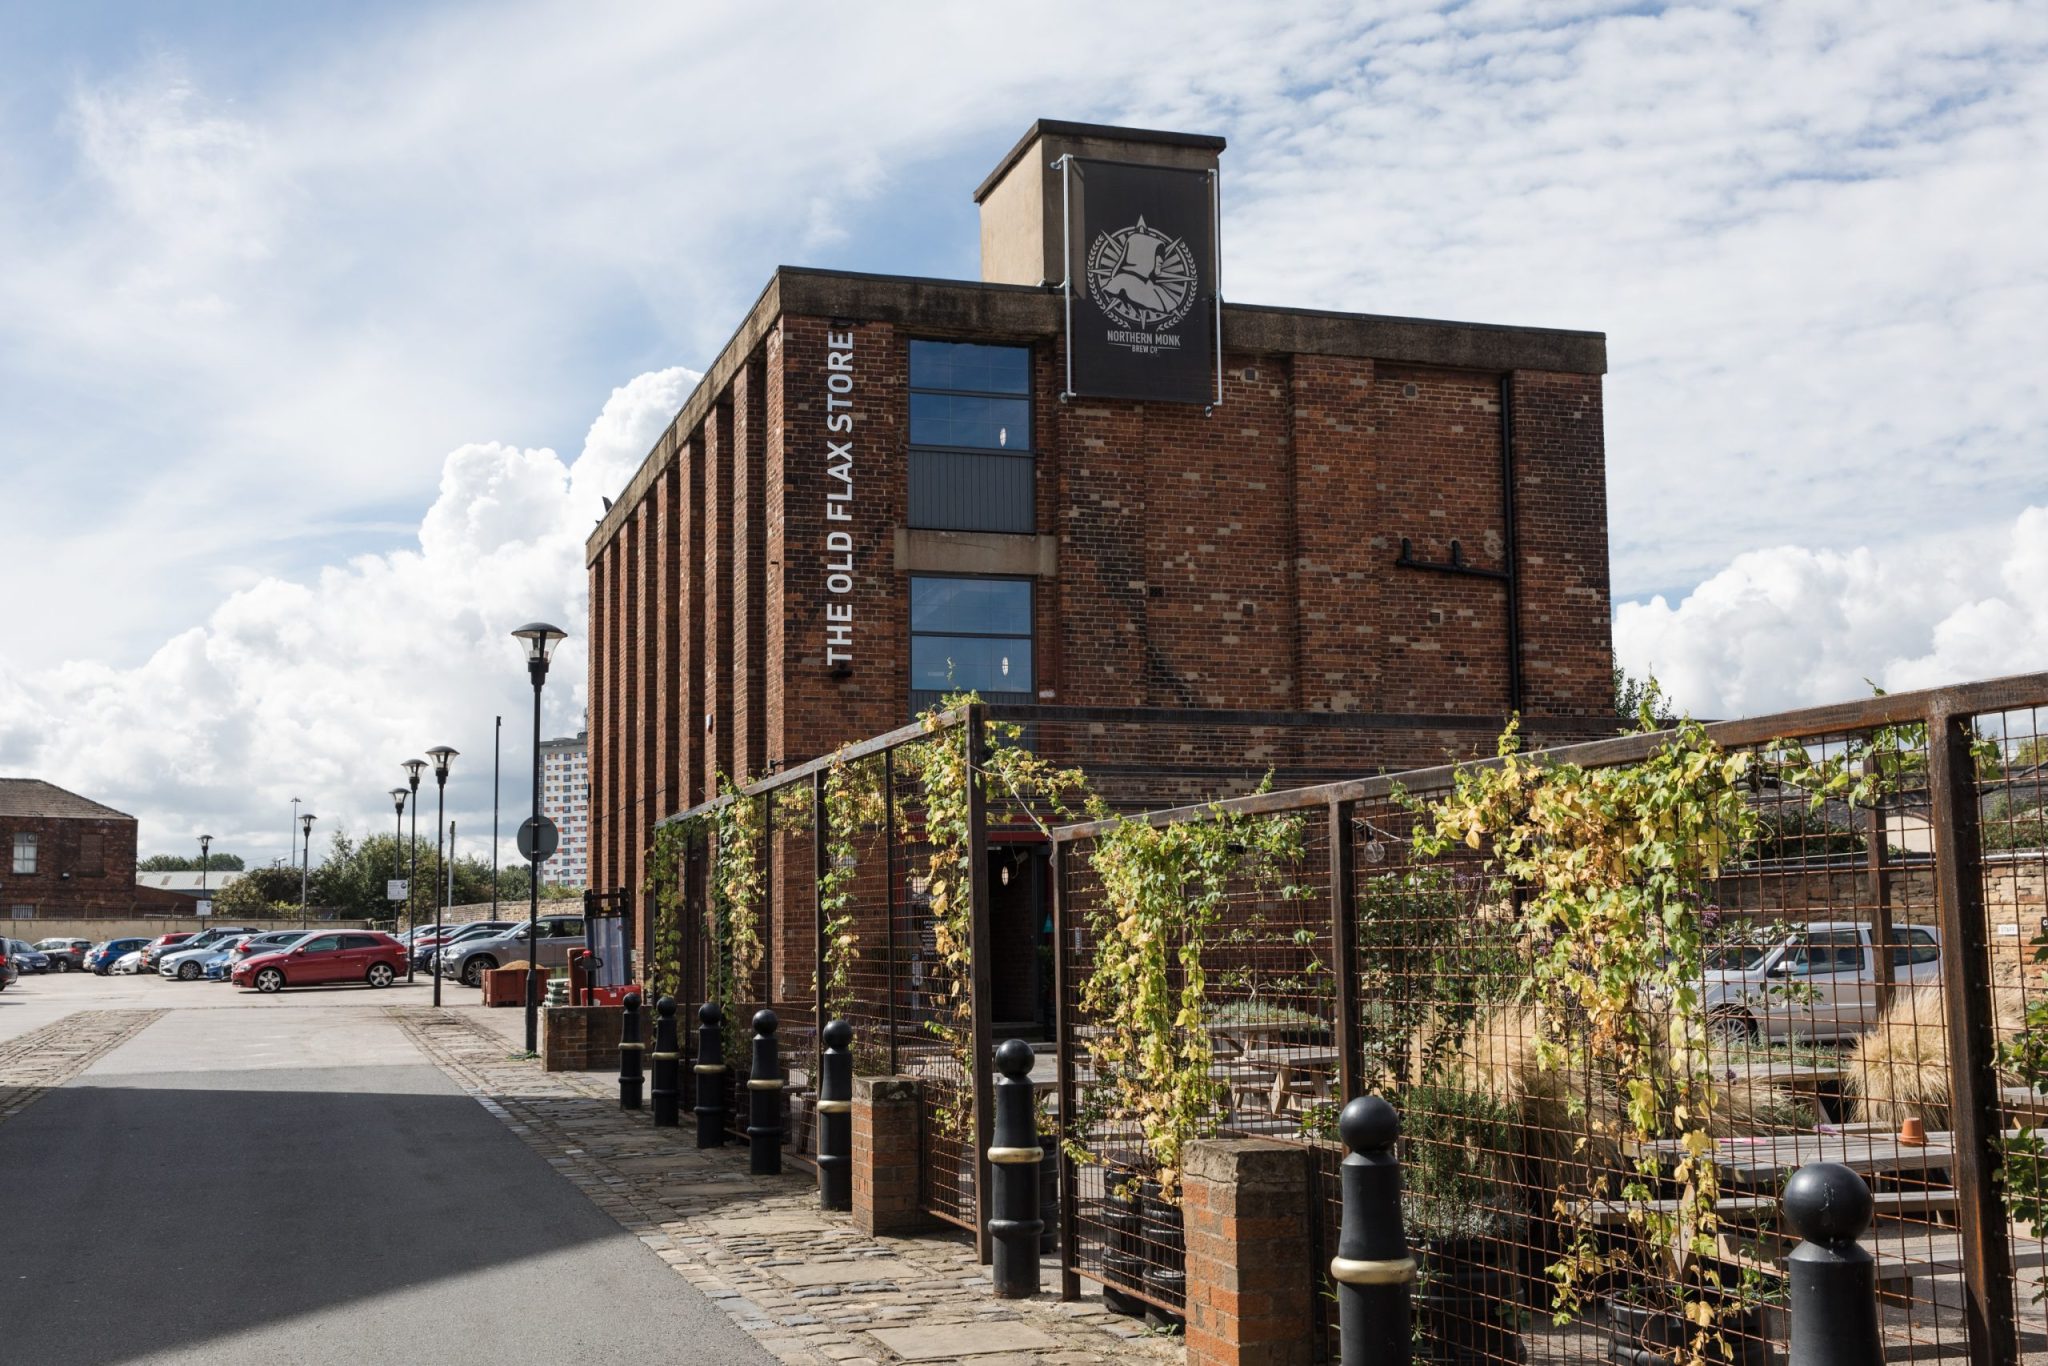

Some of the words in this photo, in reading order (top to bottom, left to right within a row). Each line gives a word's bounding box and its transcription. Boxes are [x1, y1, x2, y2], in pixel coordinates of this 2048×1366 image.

[1107, 330, 1153, 344] NORTHERN
[1155, 333, 1181, 347] MONK
[1131, 344, 1149, 353] BREW
[827, 331, 853, 433] STORE
[827, 440, 853, 521] FLAX
[826, 531, 853, 593] OLD
[827, 603, 853, 666] THE
